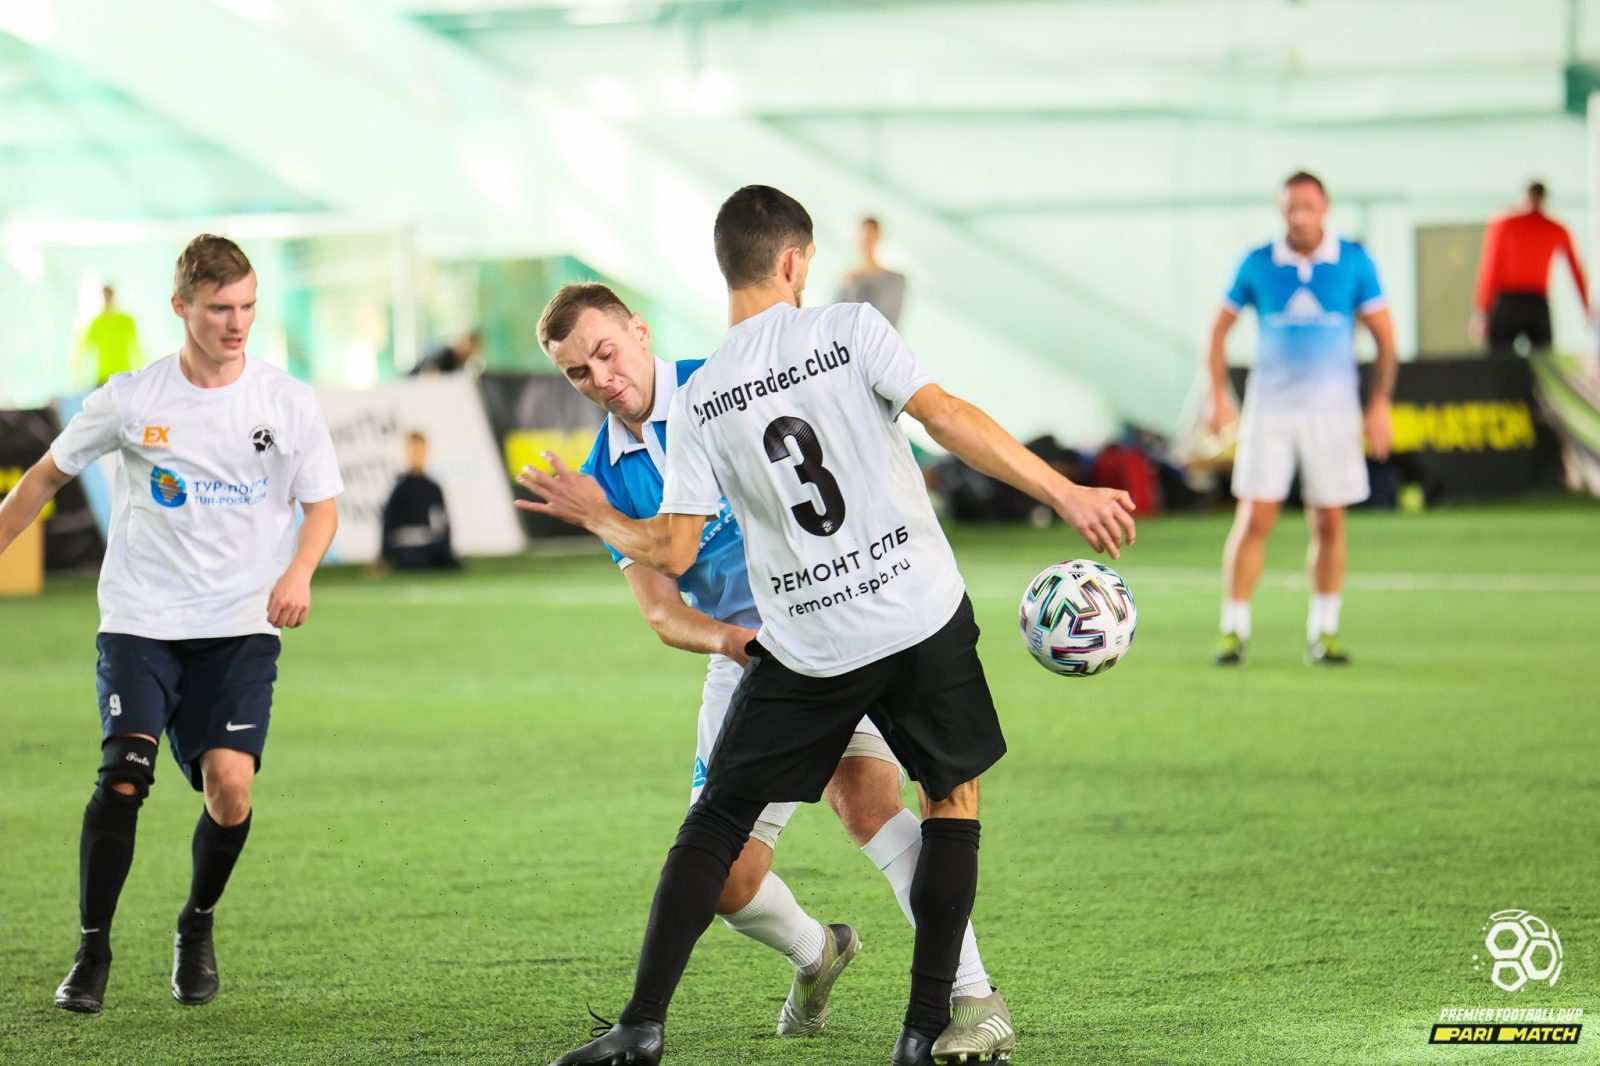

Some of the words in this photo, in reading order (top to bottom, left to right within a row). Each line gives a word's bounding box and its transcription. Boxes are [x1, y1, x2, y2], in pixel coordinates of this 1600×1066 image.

[143, 425, 172, 444] EX
[762, 415, 847, 537] 3
[770, 551, 861, 595] РЕМОНТ
[868, 525, 909, 561] СПБ
[788, 557, 911, 617] remont.spb.ru
[109, 694, 122, 716] 9
